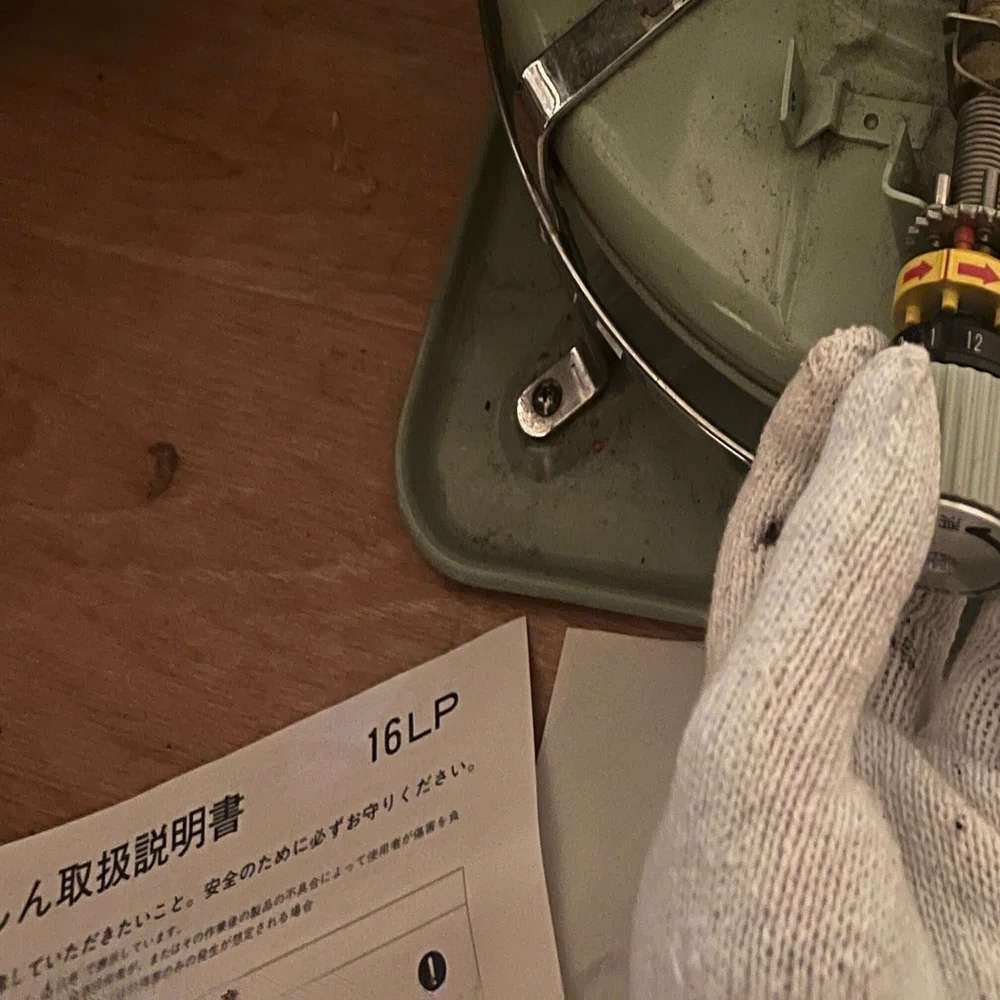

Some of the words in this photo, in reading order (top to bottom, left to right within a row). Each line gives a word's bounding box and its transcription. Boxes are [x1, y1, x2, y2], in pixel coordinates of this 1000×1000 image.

[931, 327, 936, 347] 1
[967, 330, 983, 352] 12
[368, 692, 459, 763] 16LP
